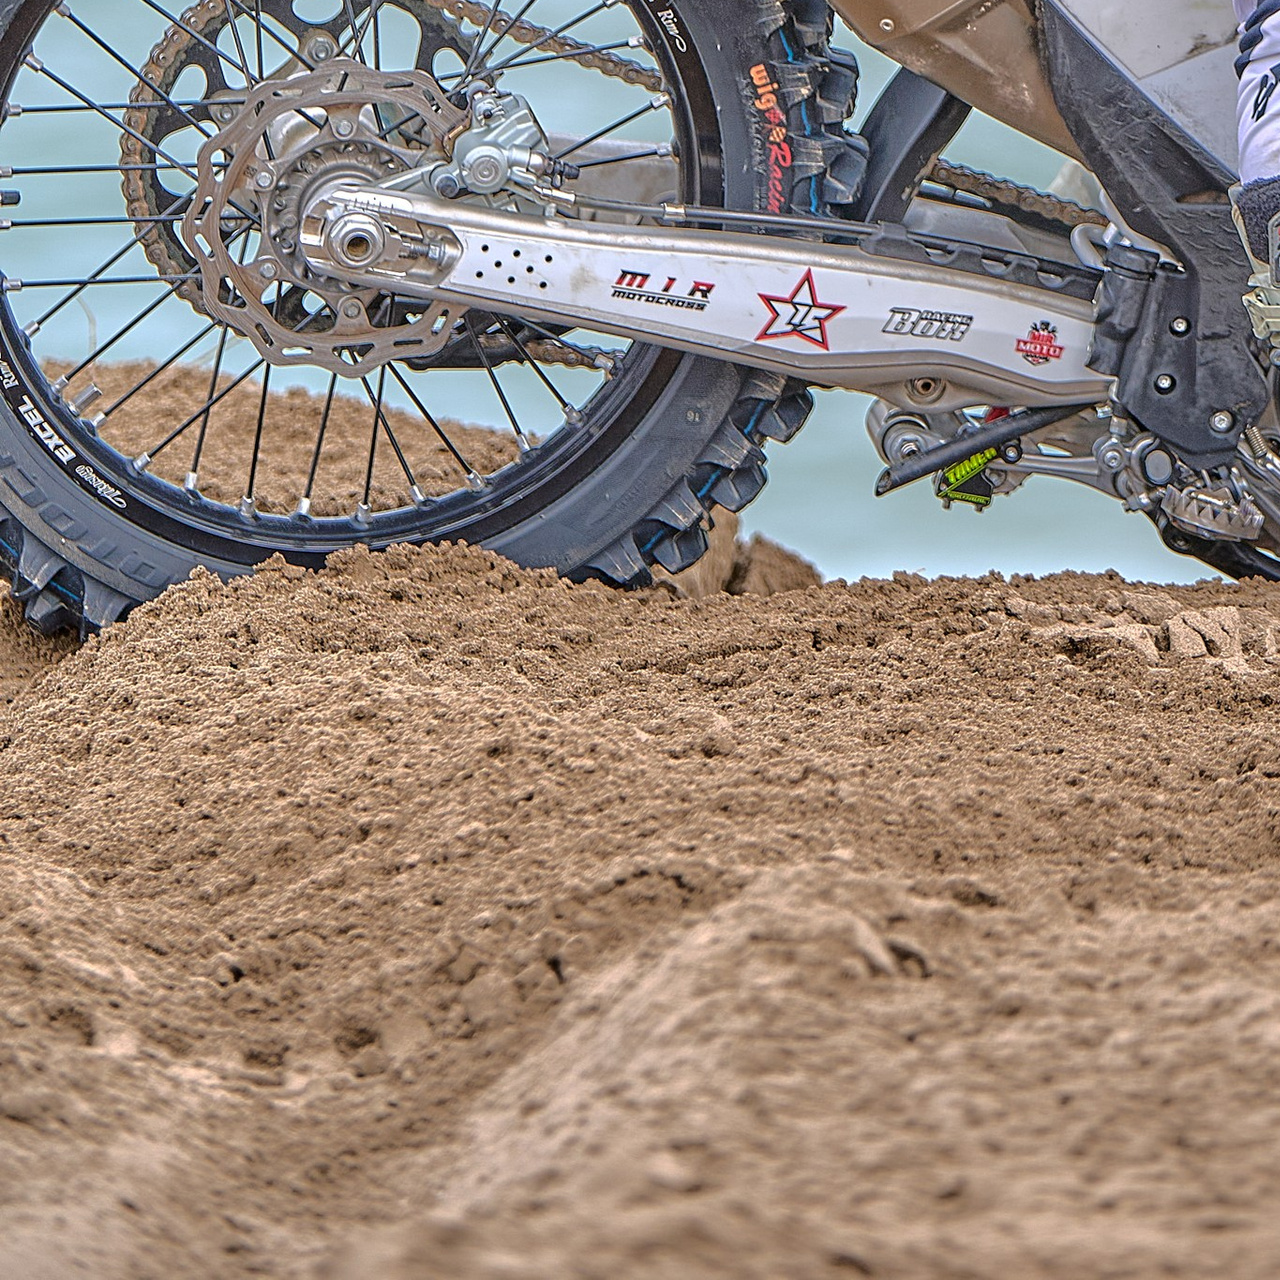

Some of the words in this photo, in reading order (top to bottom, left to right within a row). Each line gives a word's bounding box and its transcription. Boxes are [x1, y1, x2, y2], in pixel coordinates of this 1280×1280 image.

[611, 289, 709, 312] MOTOCROSS
[881, 306, 970, 342] BOX
[1018, 341, 1061, 357] MOTO
[18, 394, 77, 466] EXCEL
